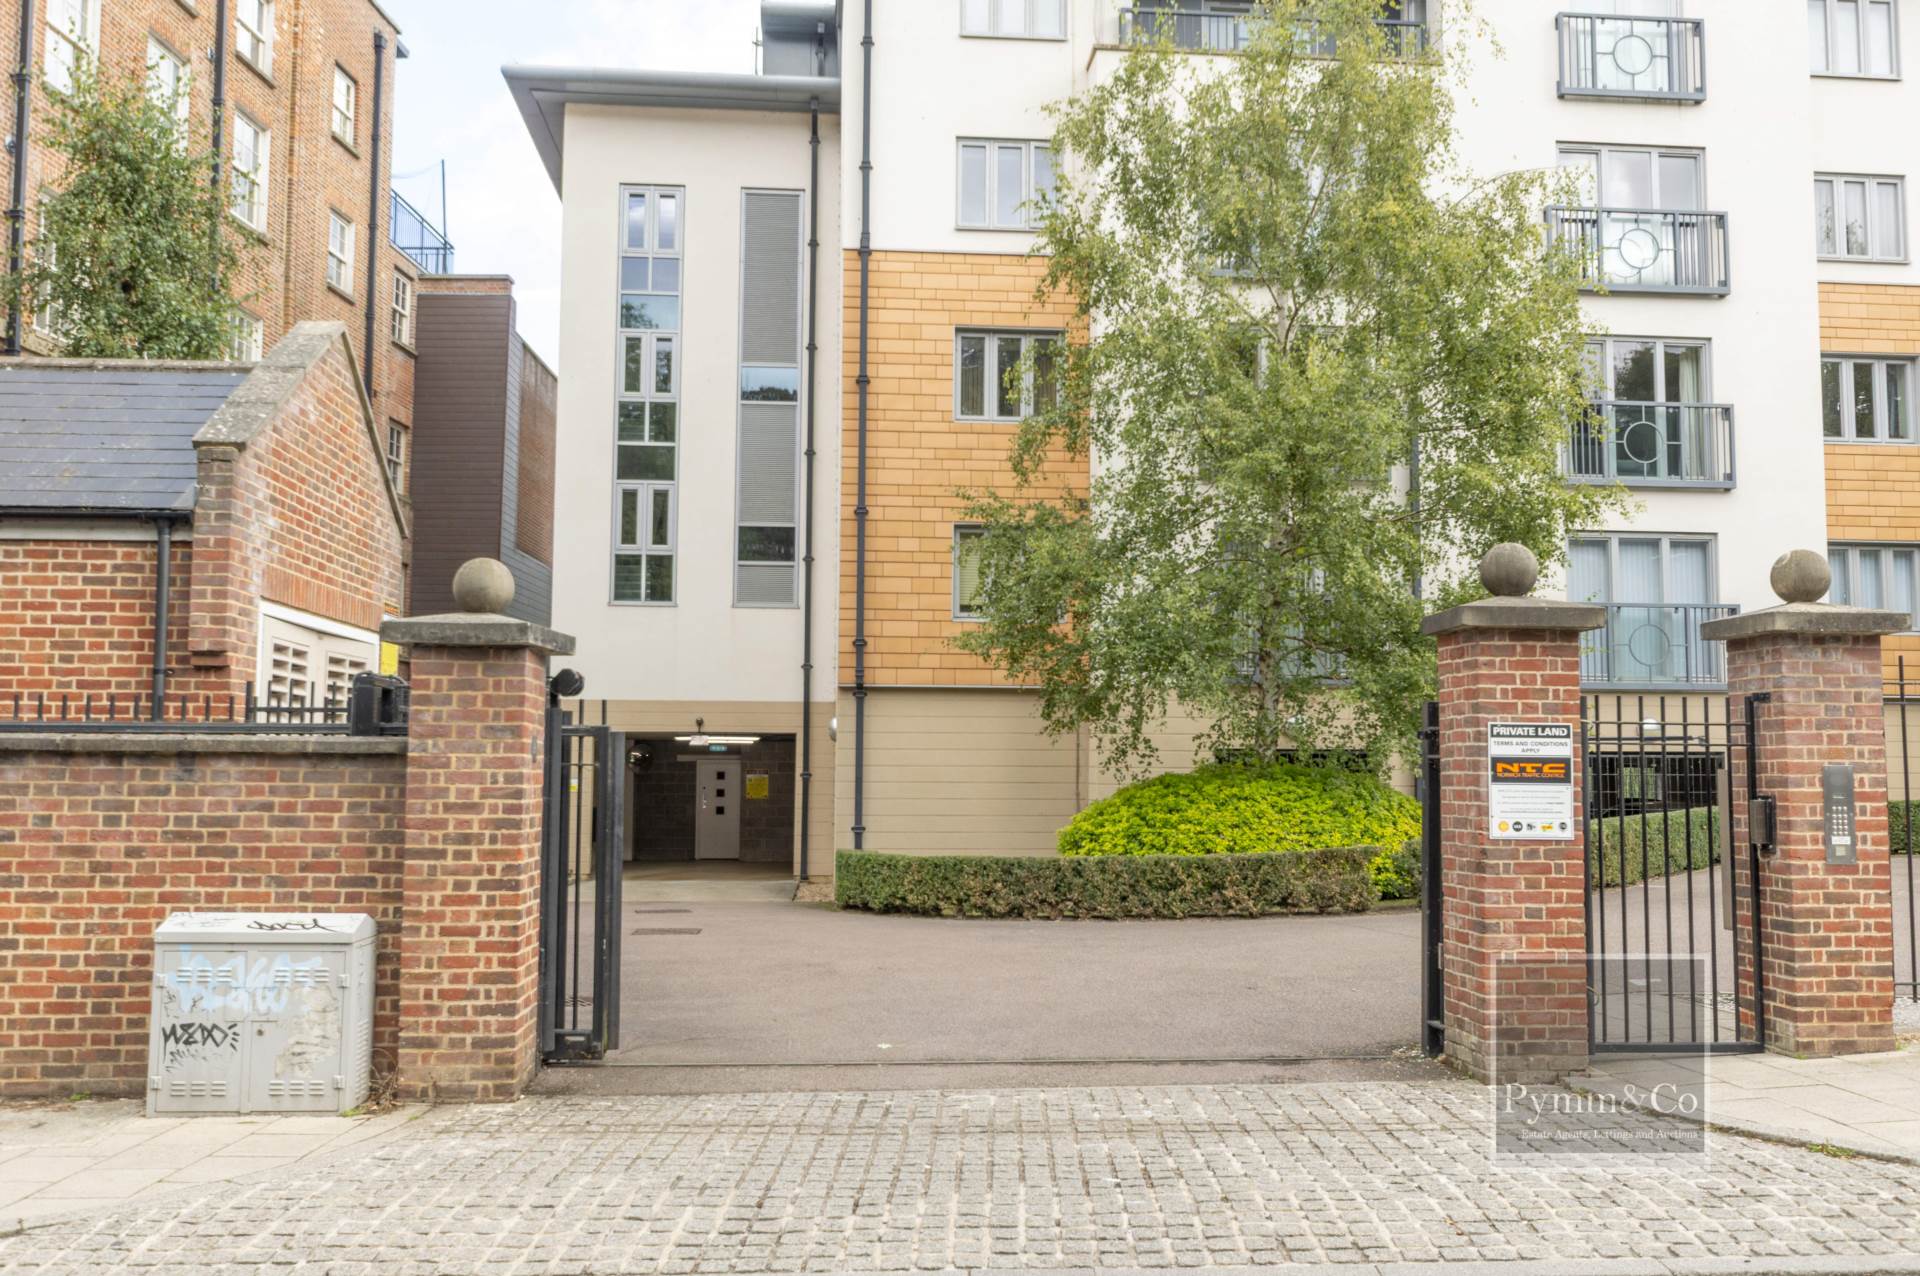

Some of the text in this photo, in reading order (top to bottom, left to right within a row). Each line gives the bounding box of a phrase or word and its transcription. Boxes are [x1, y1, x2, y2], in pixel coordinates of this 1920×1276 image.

[1493, 727, 1568, 736] PRIVATE LAND
[1496, 762, 1566, 773] NTC
